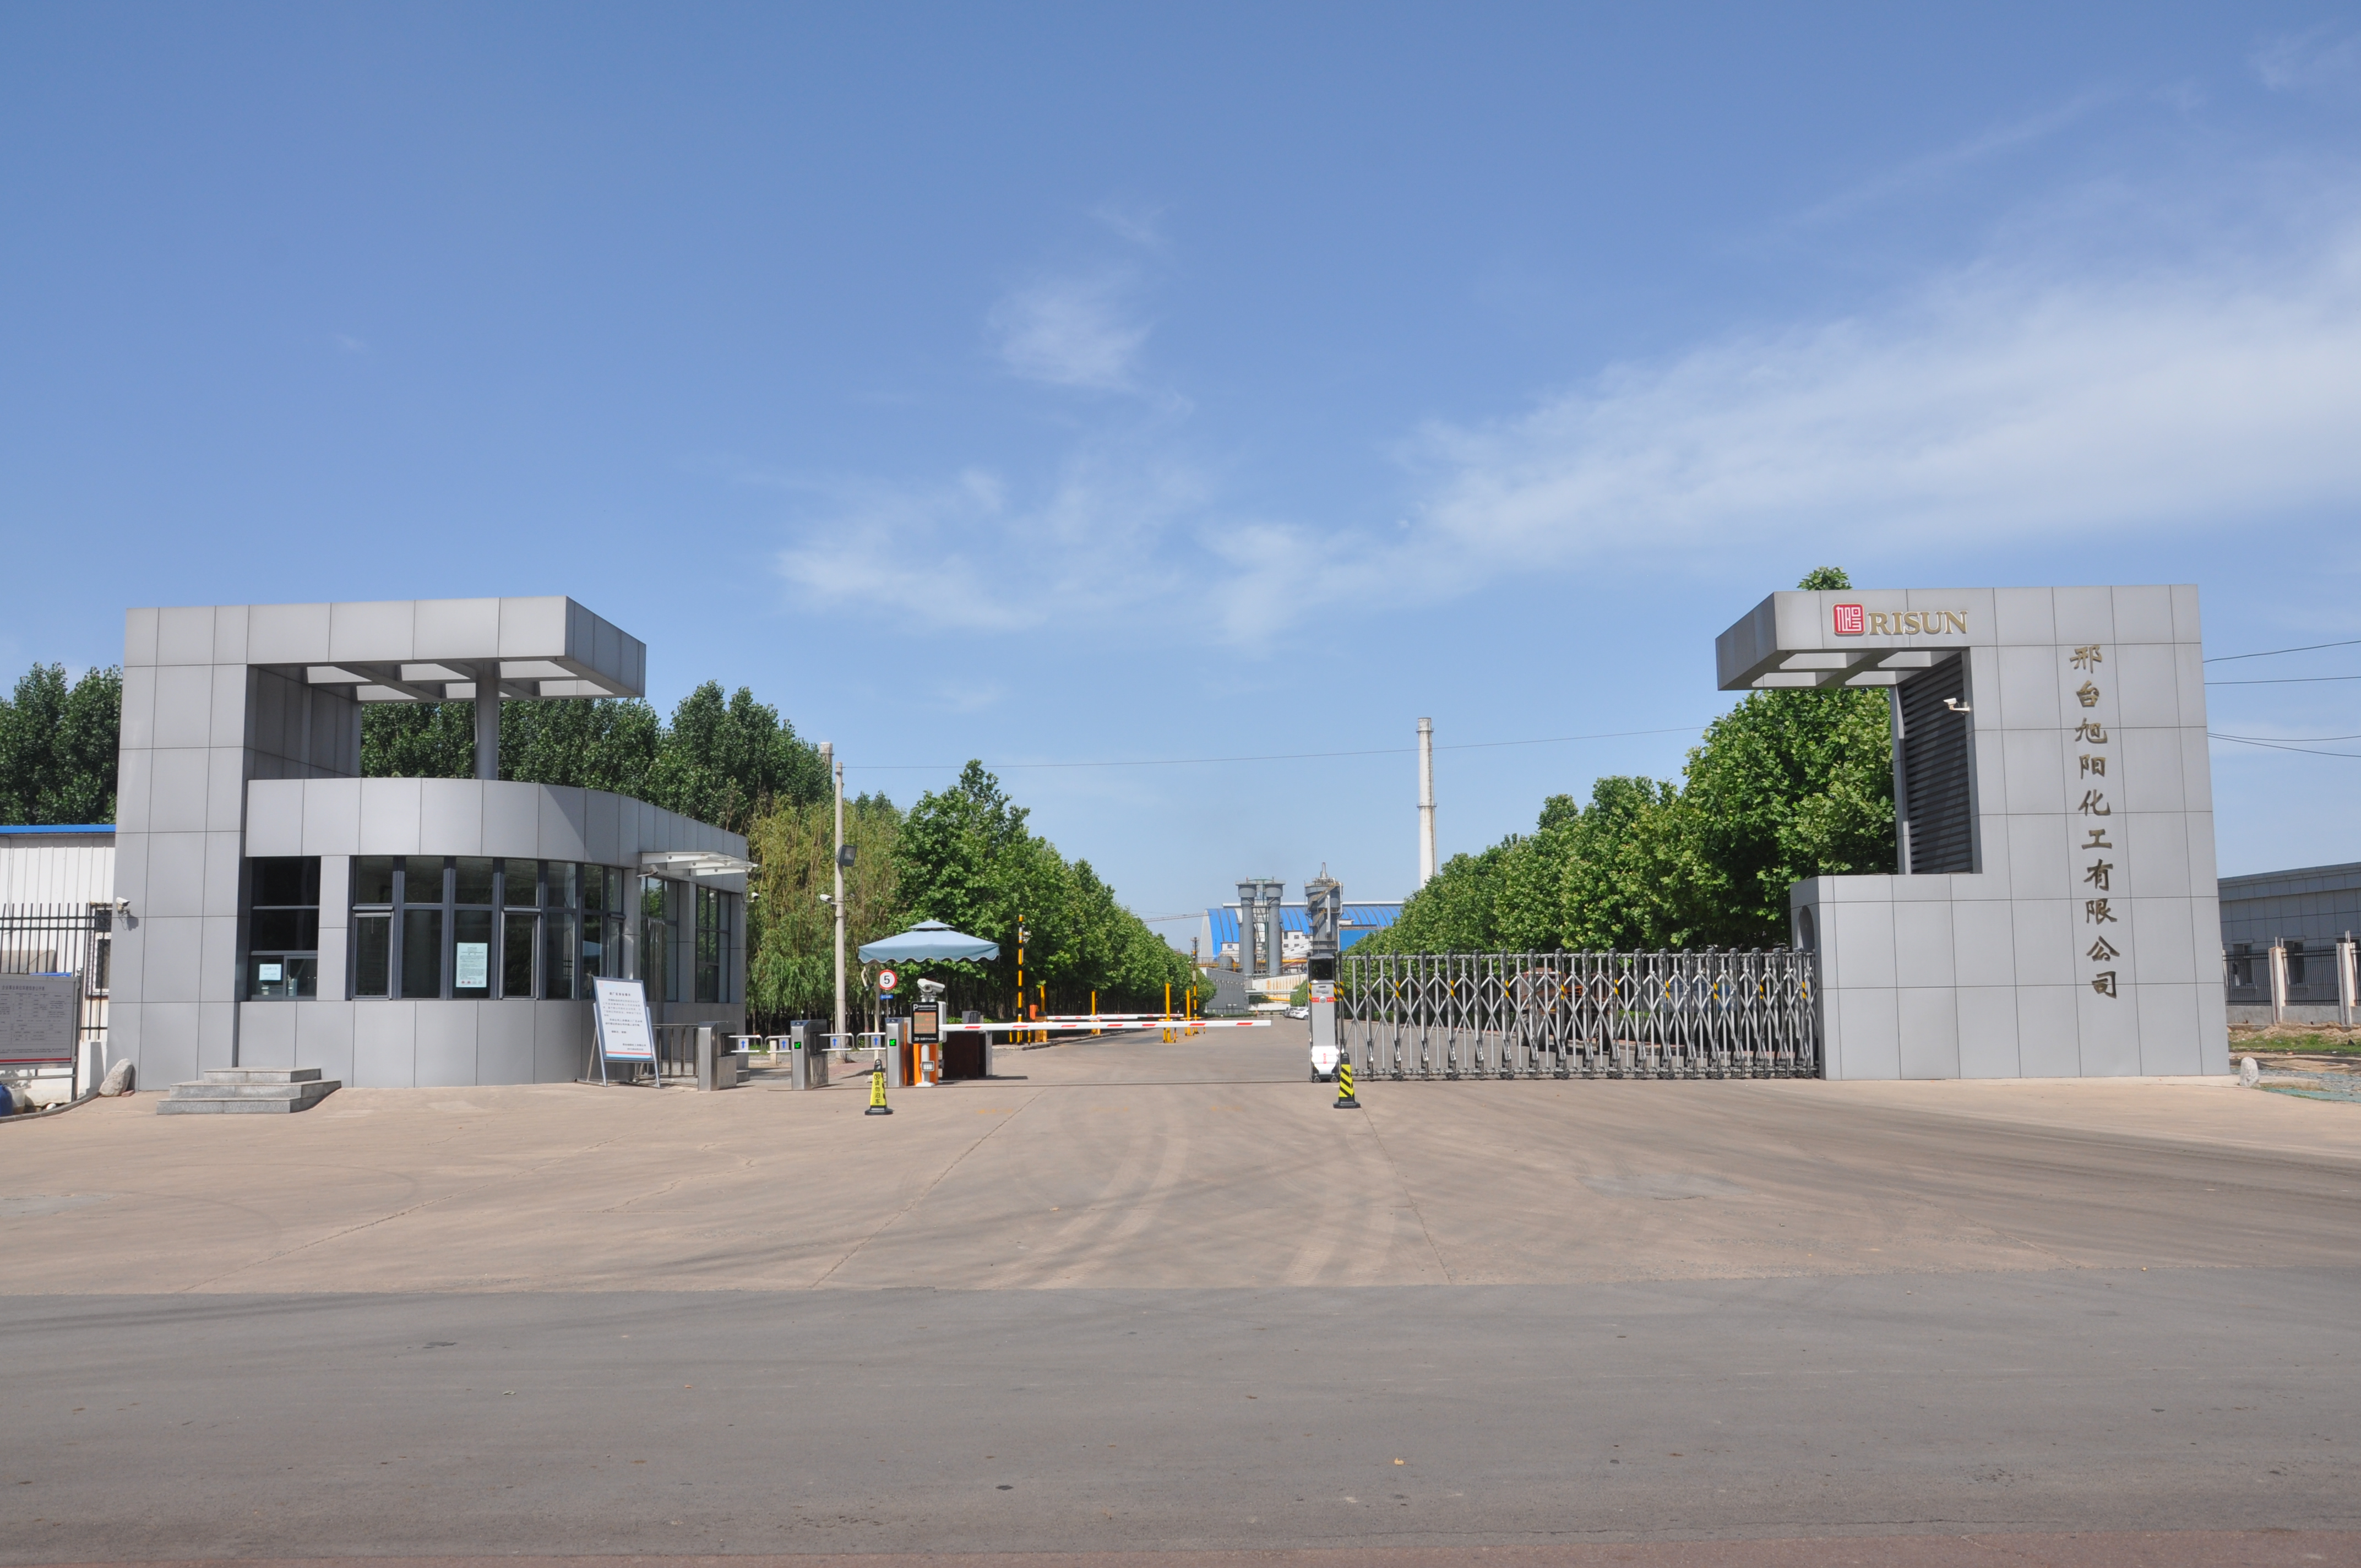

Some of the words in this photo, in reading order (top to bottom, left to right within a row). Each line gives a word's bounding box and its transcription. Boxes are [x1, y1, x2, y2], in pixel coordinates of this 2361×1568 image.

[1867, 610, 1968, 635] RISUN
[2070, 644, 2120, 999] 邢台旭阳化工有限公司
[884, 975, 890, 984] 5
